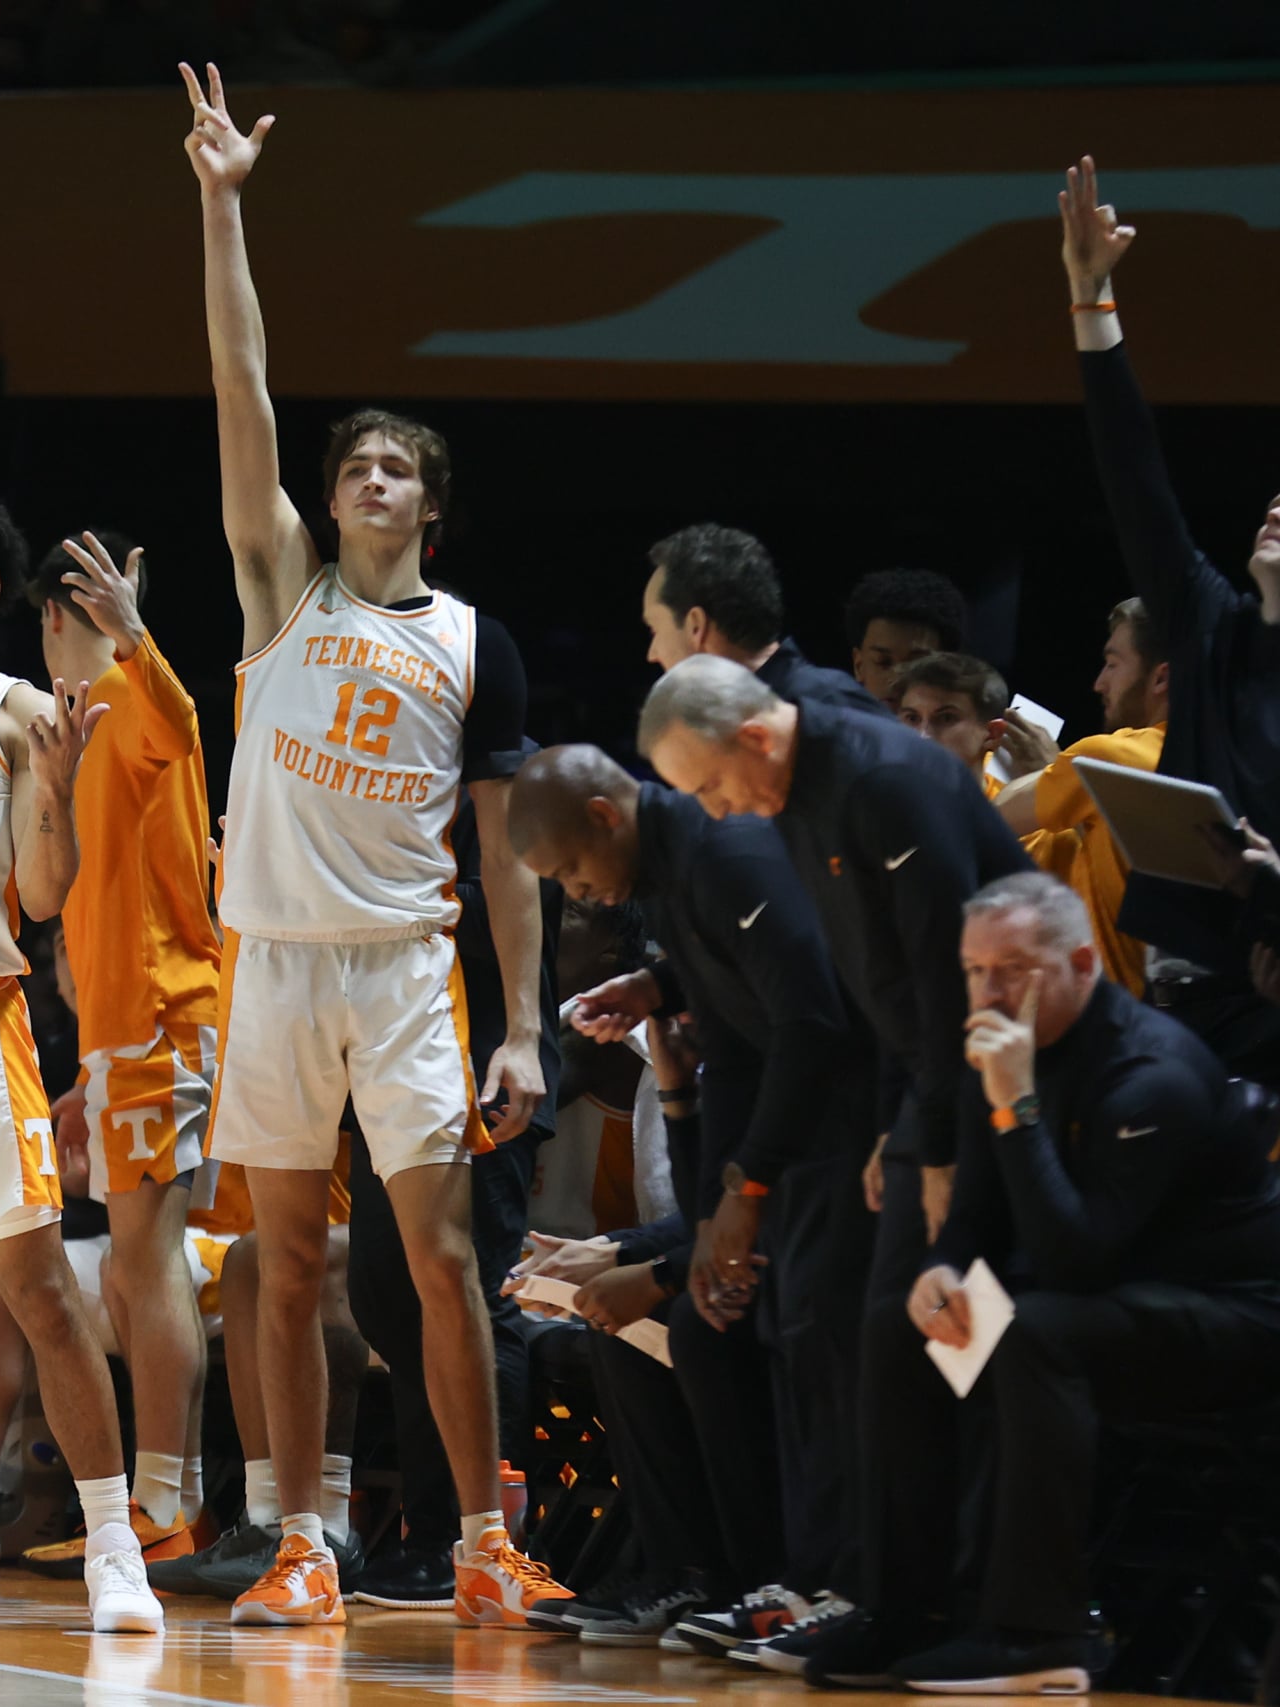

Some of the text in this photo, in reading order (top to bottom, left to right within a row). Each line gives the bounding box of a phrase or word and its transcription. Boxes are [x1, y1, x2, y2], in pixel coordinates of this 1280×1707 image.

[303, 634, 450, 704] TENNESSEE
[325, 681, 401, 757] 12
[273, 728, 433, 804] VOLUNTEERS
[23, 1118, 56, 1175] T
[111, 1106, 163, 1161] T
